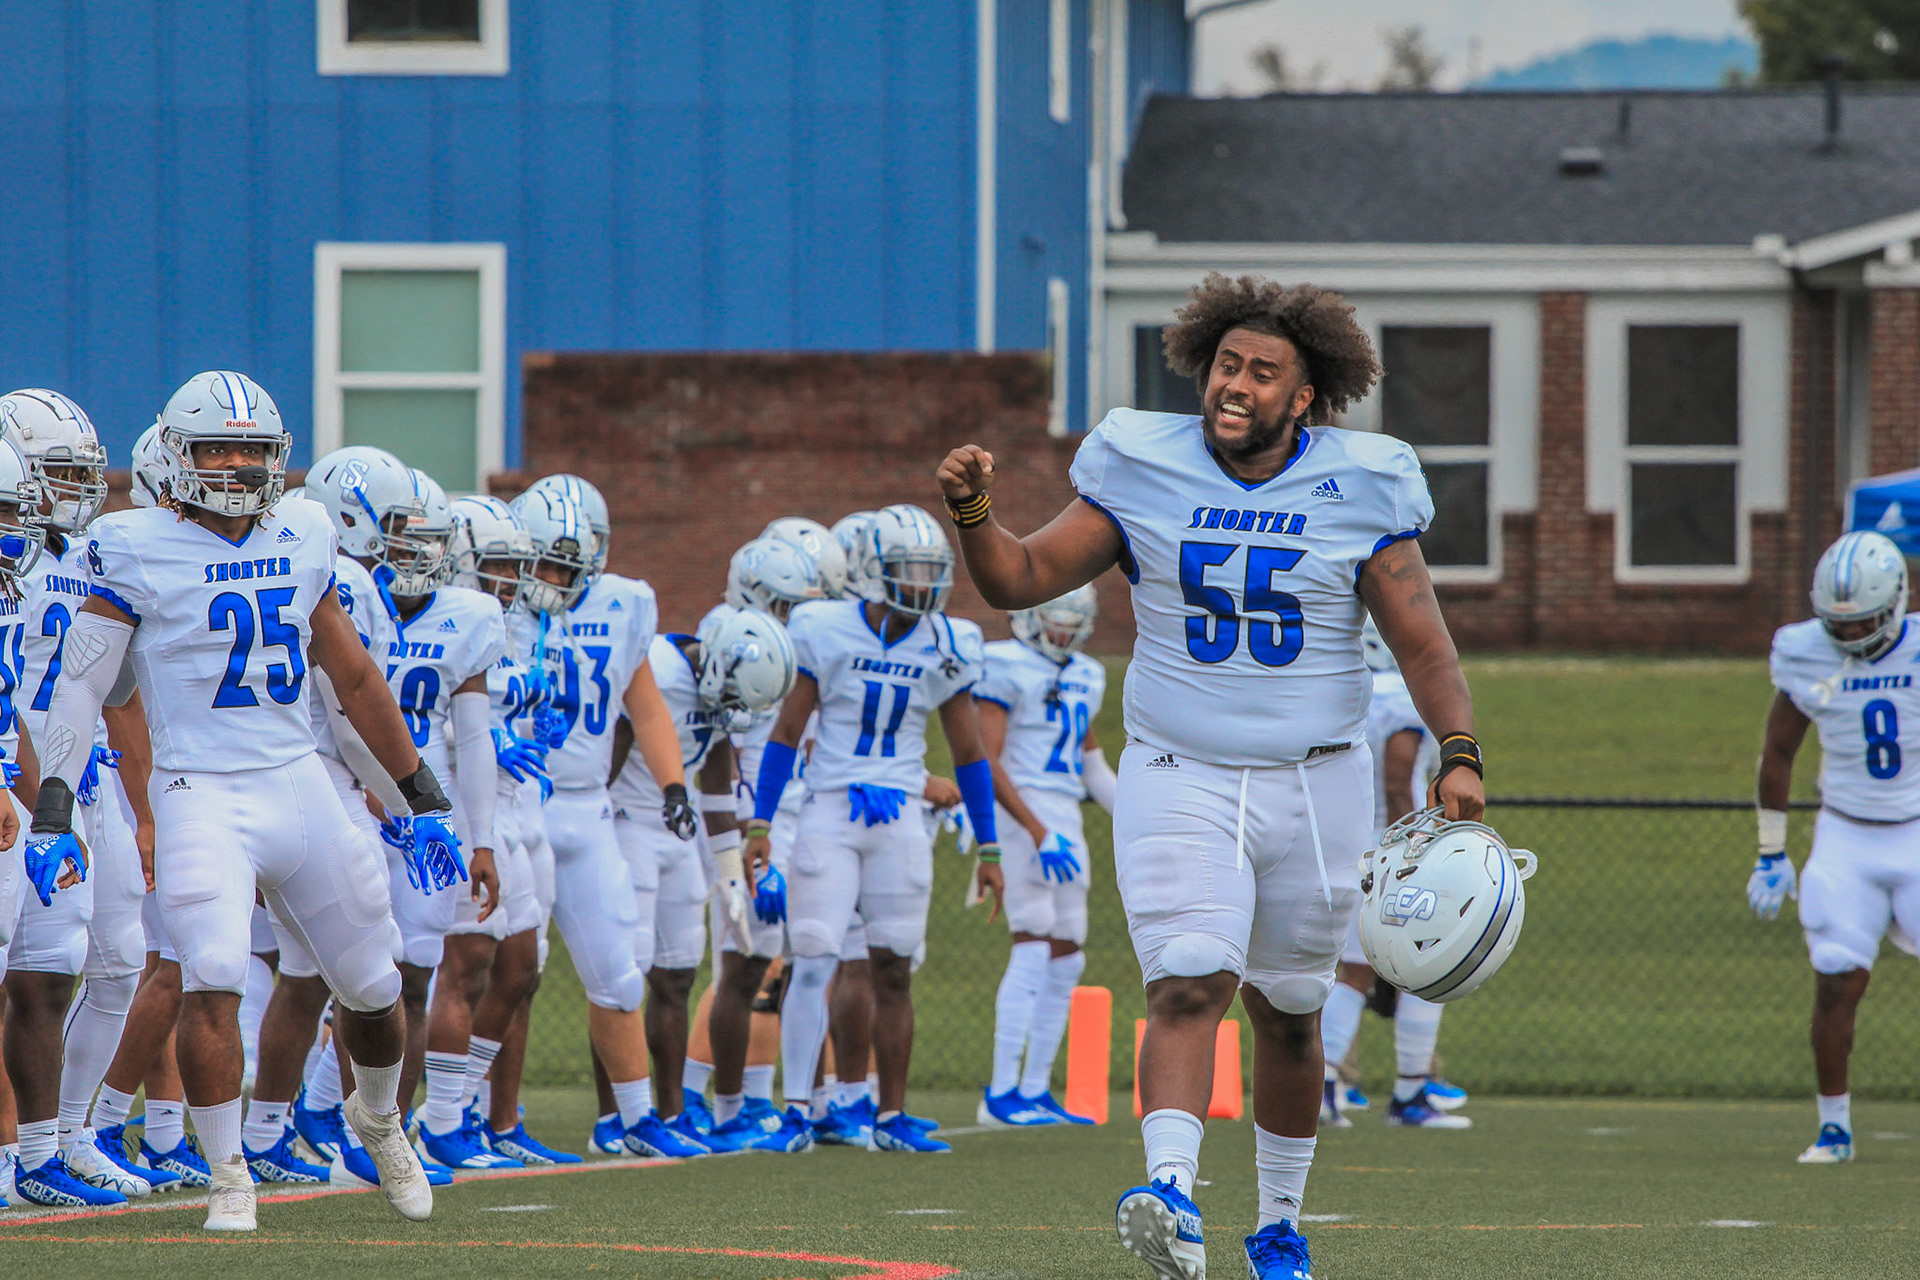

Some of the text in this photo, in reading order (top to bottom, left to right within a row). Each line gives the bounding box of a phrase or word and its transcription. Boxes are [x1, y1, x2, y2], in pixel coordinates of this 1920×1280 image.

[226, 420, 257, 429] Riddell
[1310, 489, 1344, 501] adidas
[1187, 506, 1308, 536] SHORTER
[276, 535, 302, 544] adidas
[204, 556, 292, 584] SHORTER
[1178, 540, 1309, 668] 55
[208, 585, 306, 710] 25
[853, 679, 911, 758] 11
[1862, 697, 1902, 780] 8
